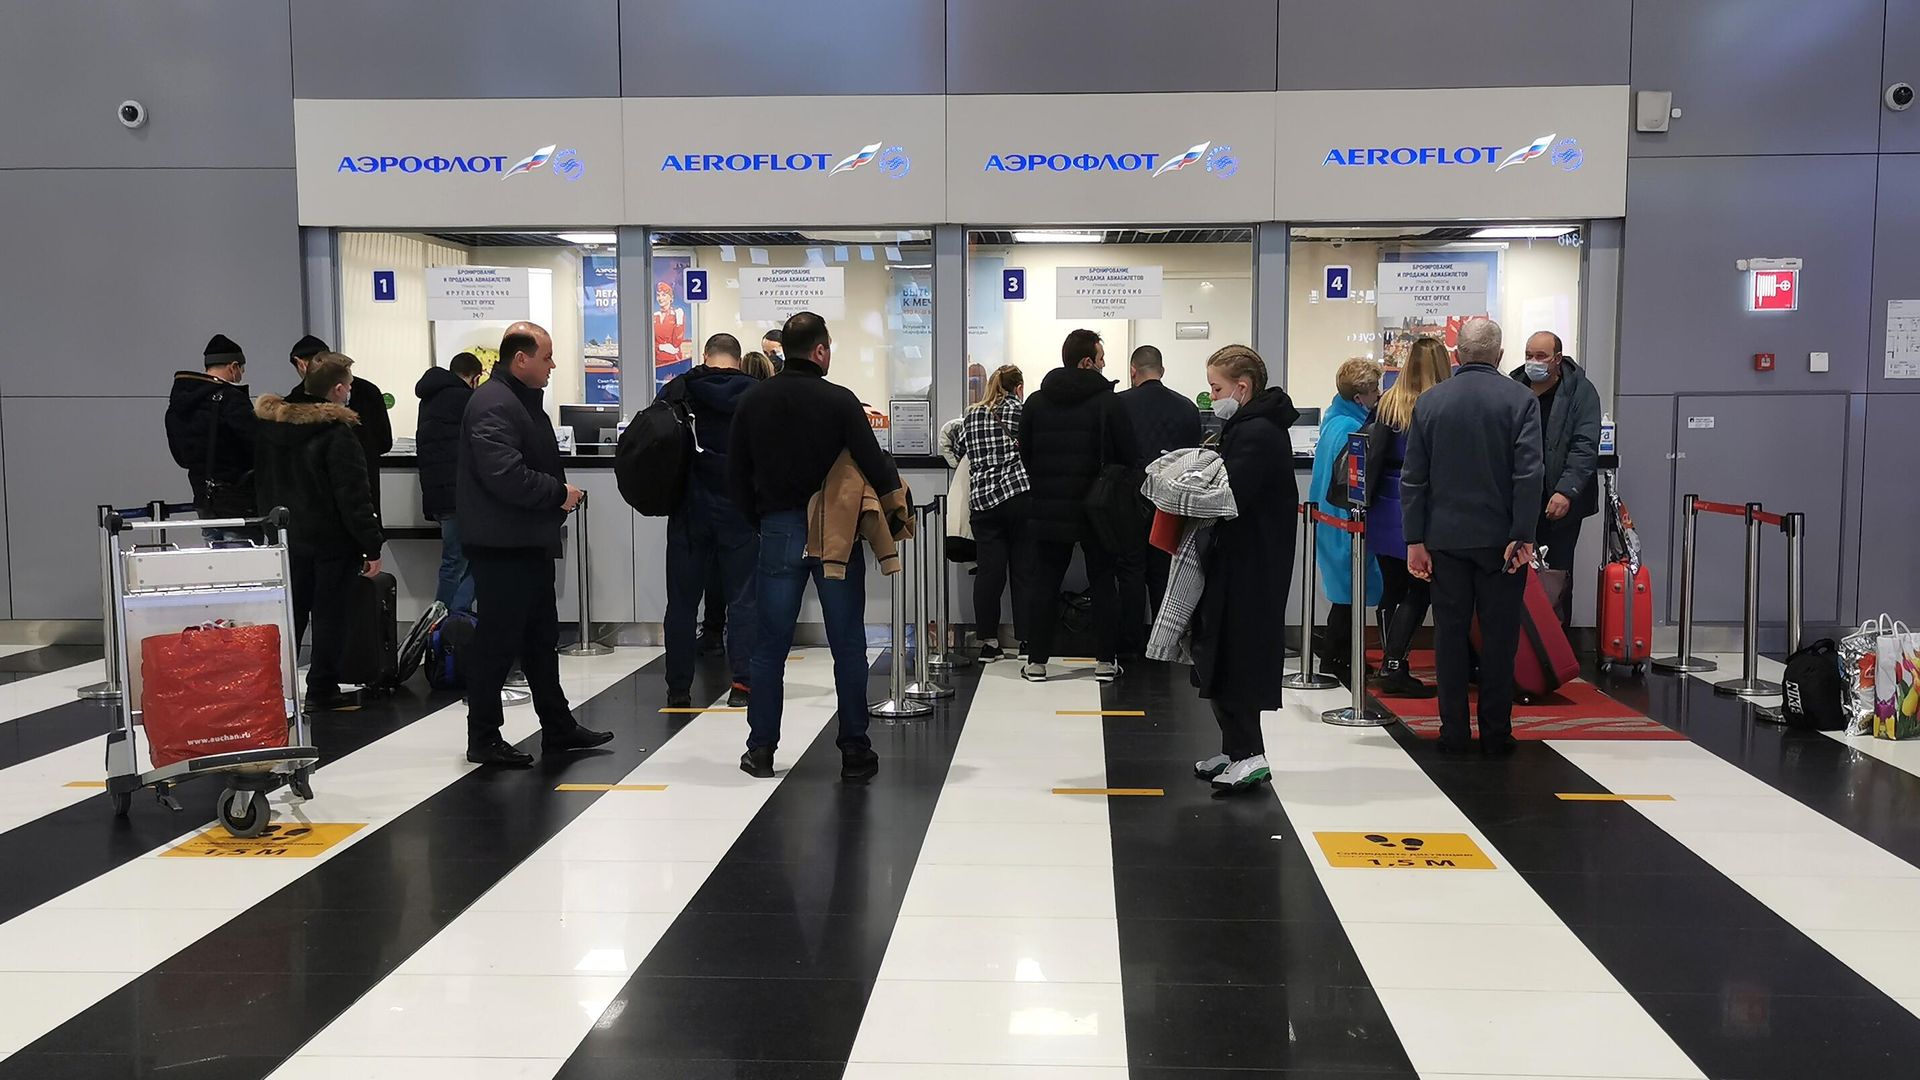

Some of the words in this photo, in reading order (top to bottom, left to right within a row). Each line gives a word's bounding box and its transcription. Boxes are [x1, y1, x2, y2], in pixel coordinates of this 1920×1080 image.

[338, 156, 507, 173] АЭРОФЛОТ
[661, 154, 832, 171] AEROFLOT
[985, 154, 1160, 171] АЭРОФЛОТ
[1322, 147, 1502, 167] AEROFLOT
[380, 279, 387, 293] 1
[691, 278, 702, 293] 2
[1008, 277, 1018, 292] 3
[1331, 276, 1343, 291] 4
[595, 289, 618, 298] ЛЕТА
[596, 298, 609, 307] ПО
[903, 298, 910, 306] К
[1785, 680, 1804, 714] NIKE
[187, 732, 251, 745] www.auchan.ru
[204, 848, 251, 857] 1,5
[1367, 859, 1415, 867] 1,5
[1425, 859, 1456, 867] М
